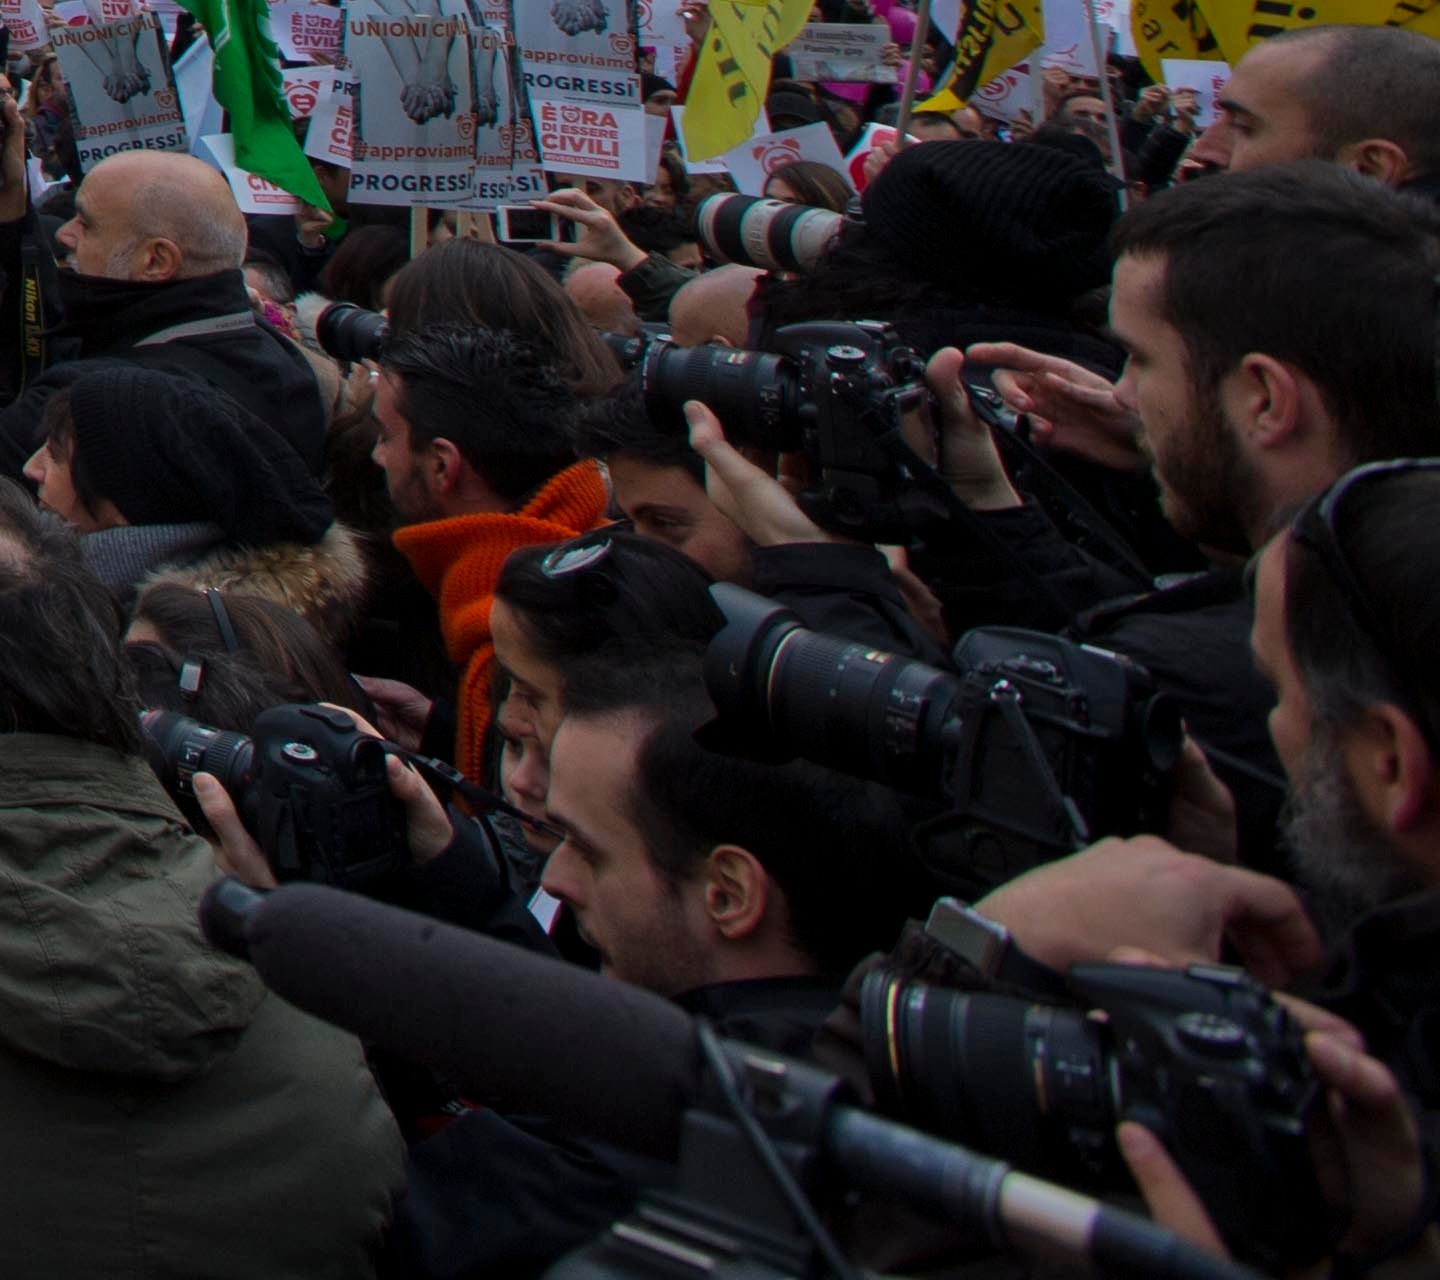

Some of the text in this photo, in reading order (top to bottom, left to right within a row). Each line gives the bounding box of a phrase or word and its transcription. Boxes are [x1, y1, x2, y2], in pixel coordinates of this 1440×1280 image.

[350, 19, 427, 38] UNIONI
[541, 102, 618, 128] È ORA
[542, 123, 618, 139] DI ESSERE
[541, 133, 619, 157] CIVILI
[350, 171, 473, 192] PROGRESSI
